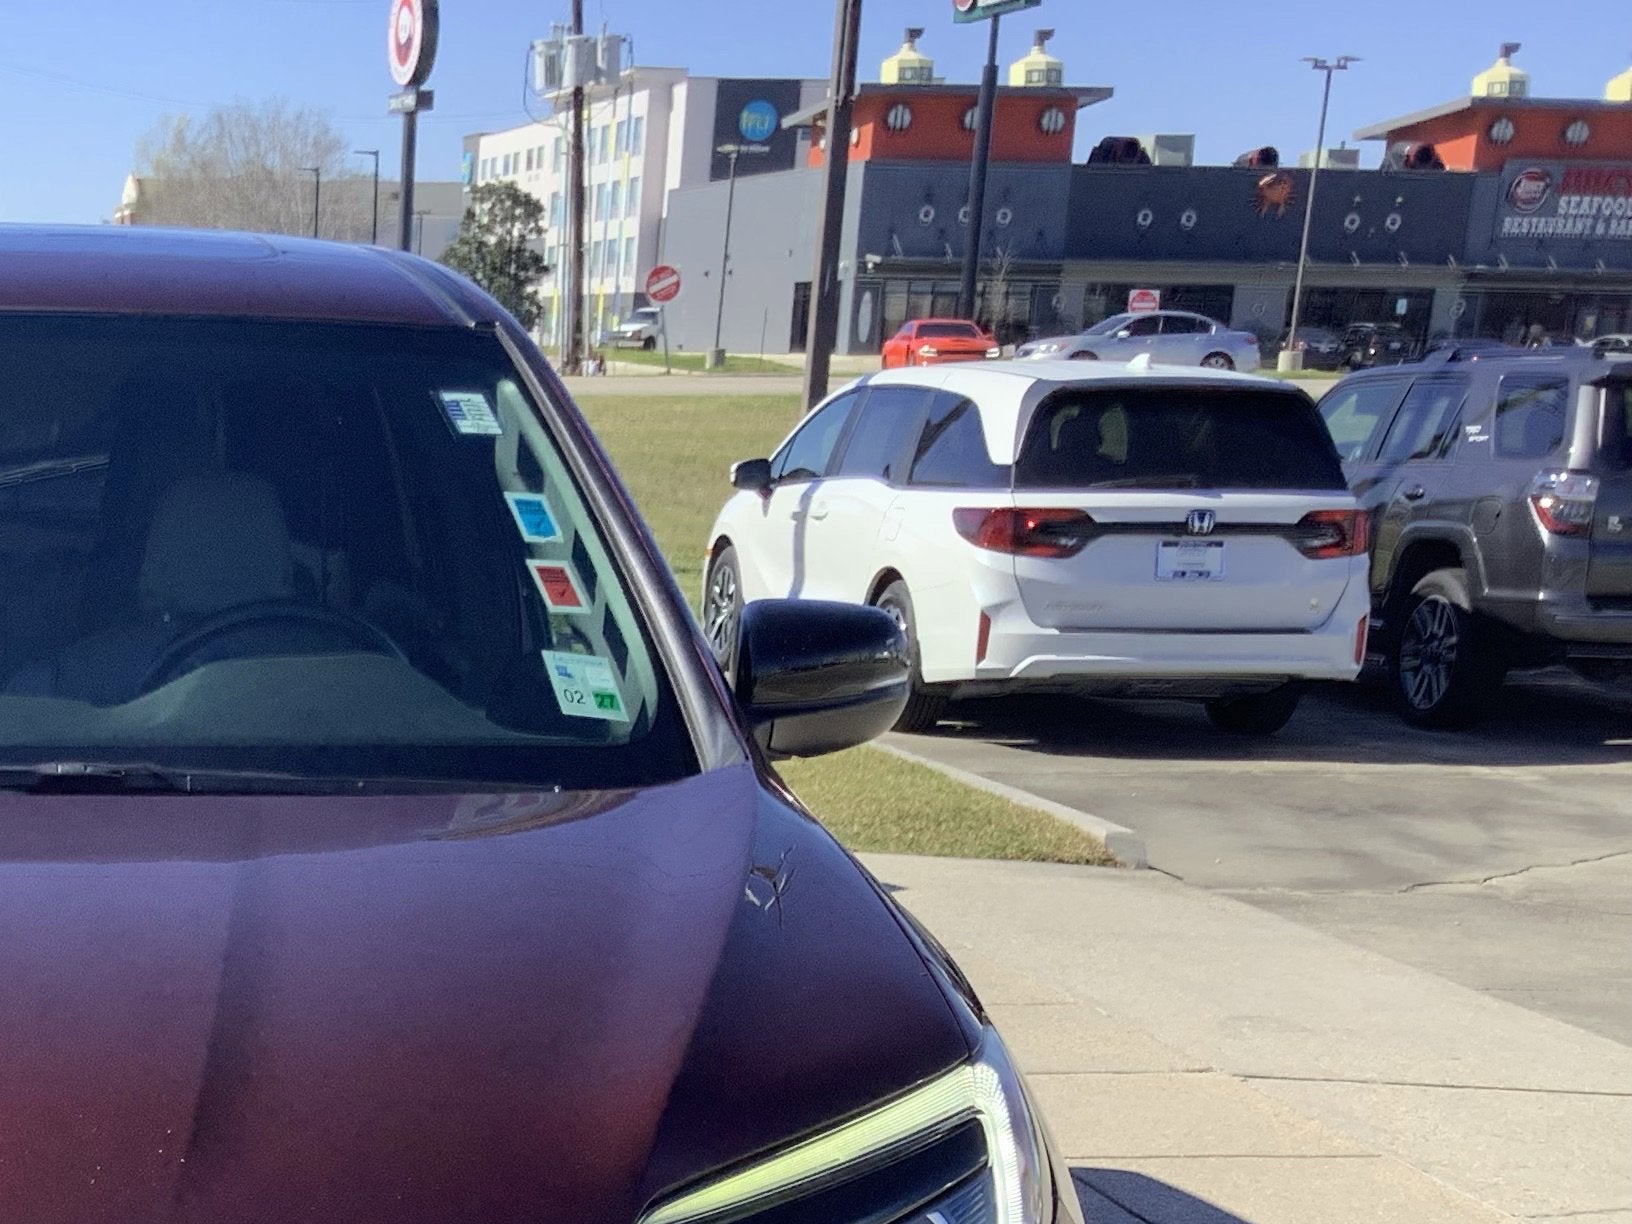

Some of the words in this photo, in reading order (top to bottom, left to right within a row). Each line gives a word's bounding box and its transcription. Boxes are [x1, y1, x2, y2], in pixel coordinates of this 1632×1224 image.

[1501, 217, 1593, 237] RESTAURANT
[563, 688, 586, 705] 02
[593, 692, 616, 710] 27
